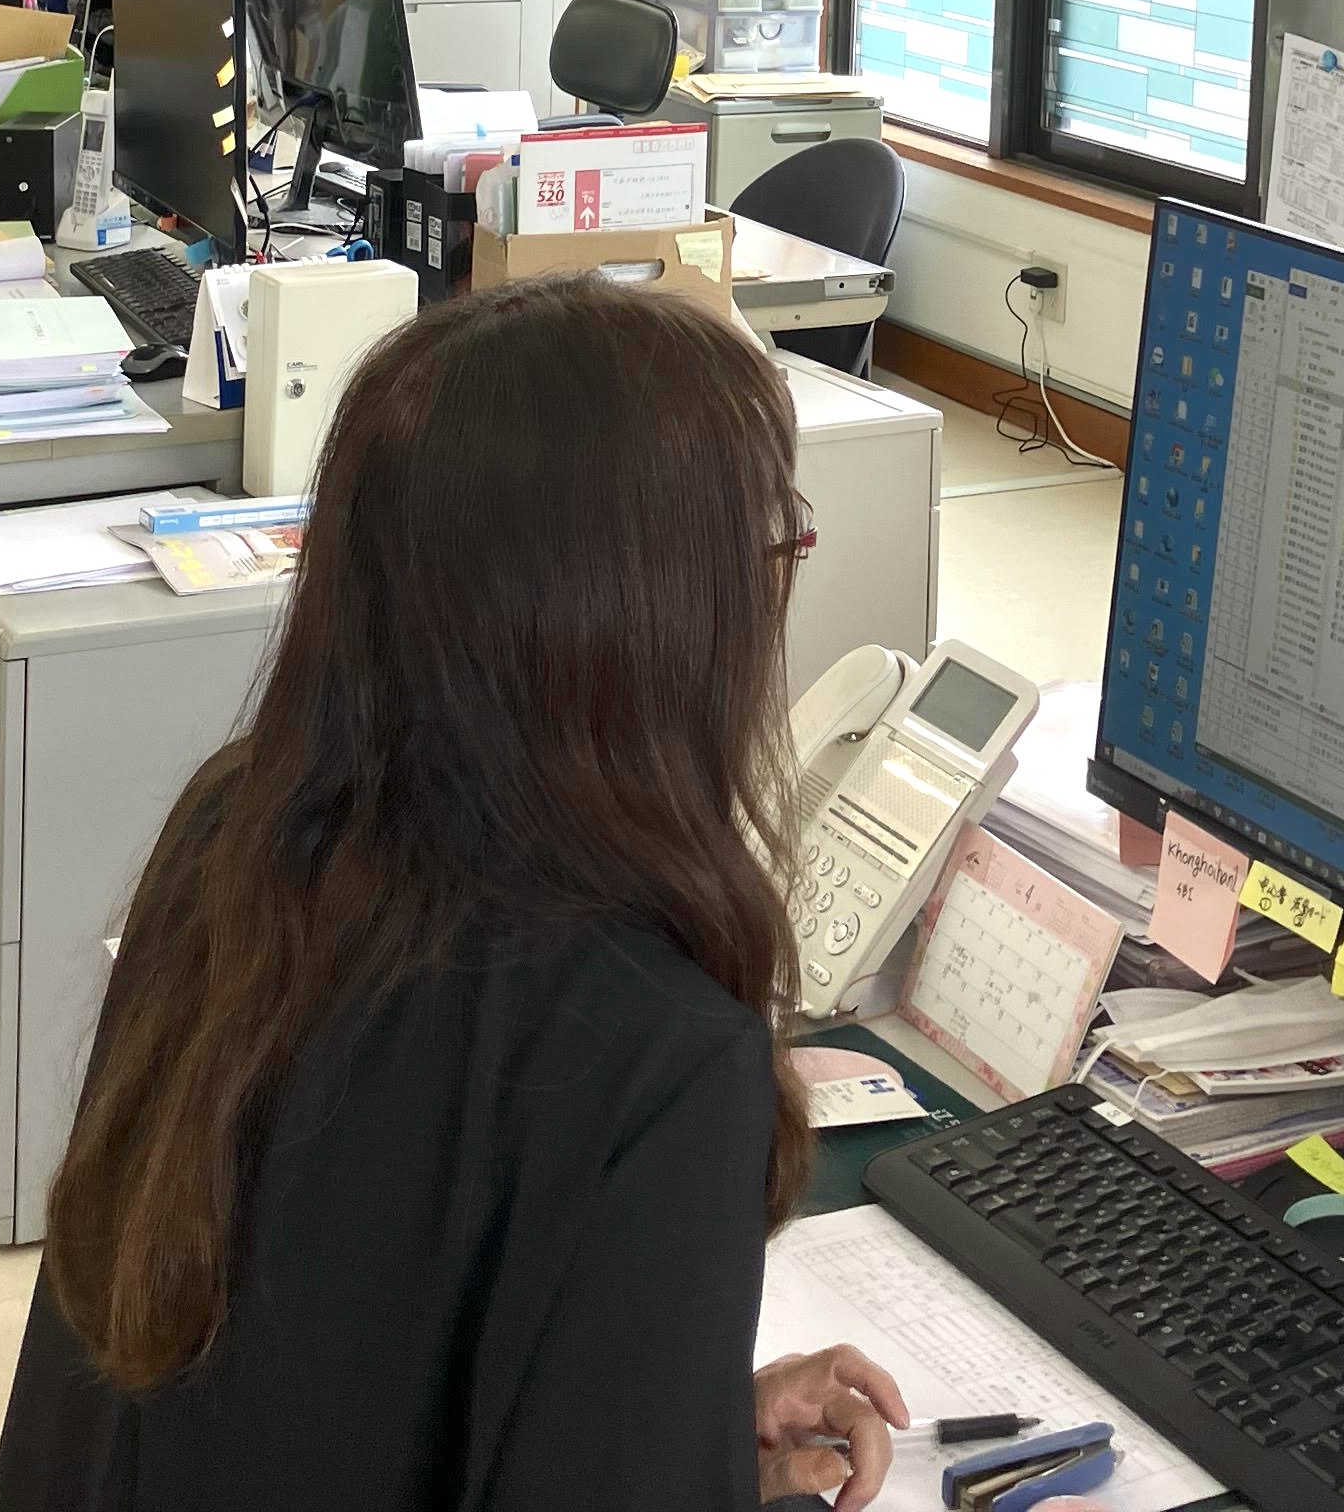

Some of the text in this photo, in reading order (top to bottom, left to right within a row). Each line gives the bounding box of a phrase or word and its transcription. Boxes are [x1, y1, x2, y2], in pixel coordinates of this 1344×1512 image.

[537, 180, 565, 190] プラス
[536, 190, 565, 203] 520
[581, 195, 595, 204] To
